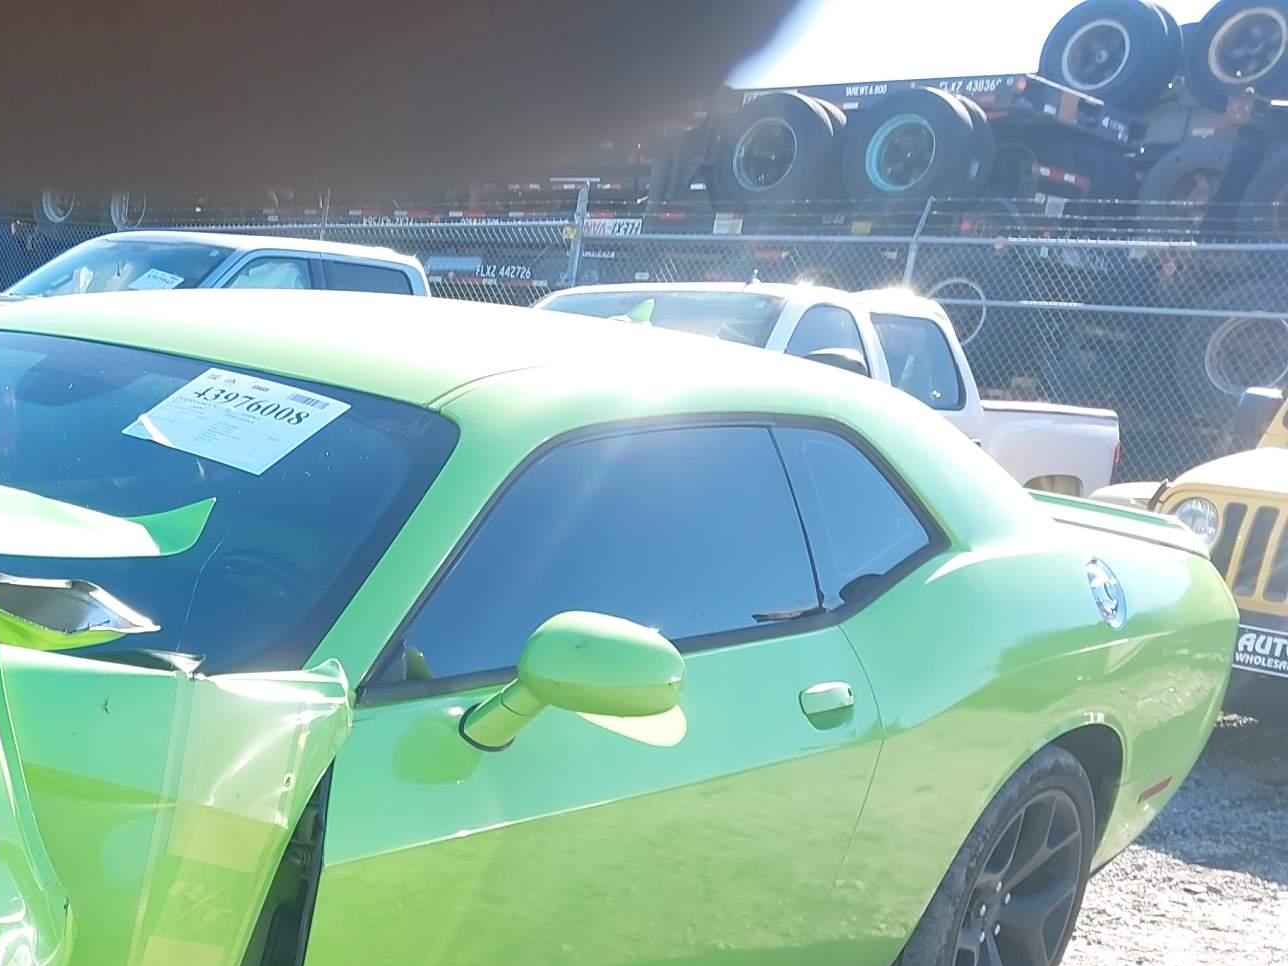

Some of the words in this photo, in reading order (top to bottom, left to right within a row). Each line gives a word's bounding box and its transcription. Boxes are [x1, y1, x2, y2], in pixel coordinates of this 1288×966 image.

[475, 263, 497, 278] FLXZ
[498, 264, 532, 280] 442726
[193, 386, 311, 425] 43976008
[1238, 632, 1288, 658] AUT
[1235, 652, 1288, 672] WHOLESA
